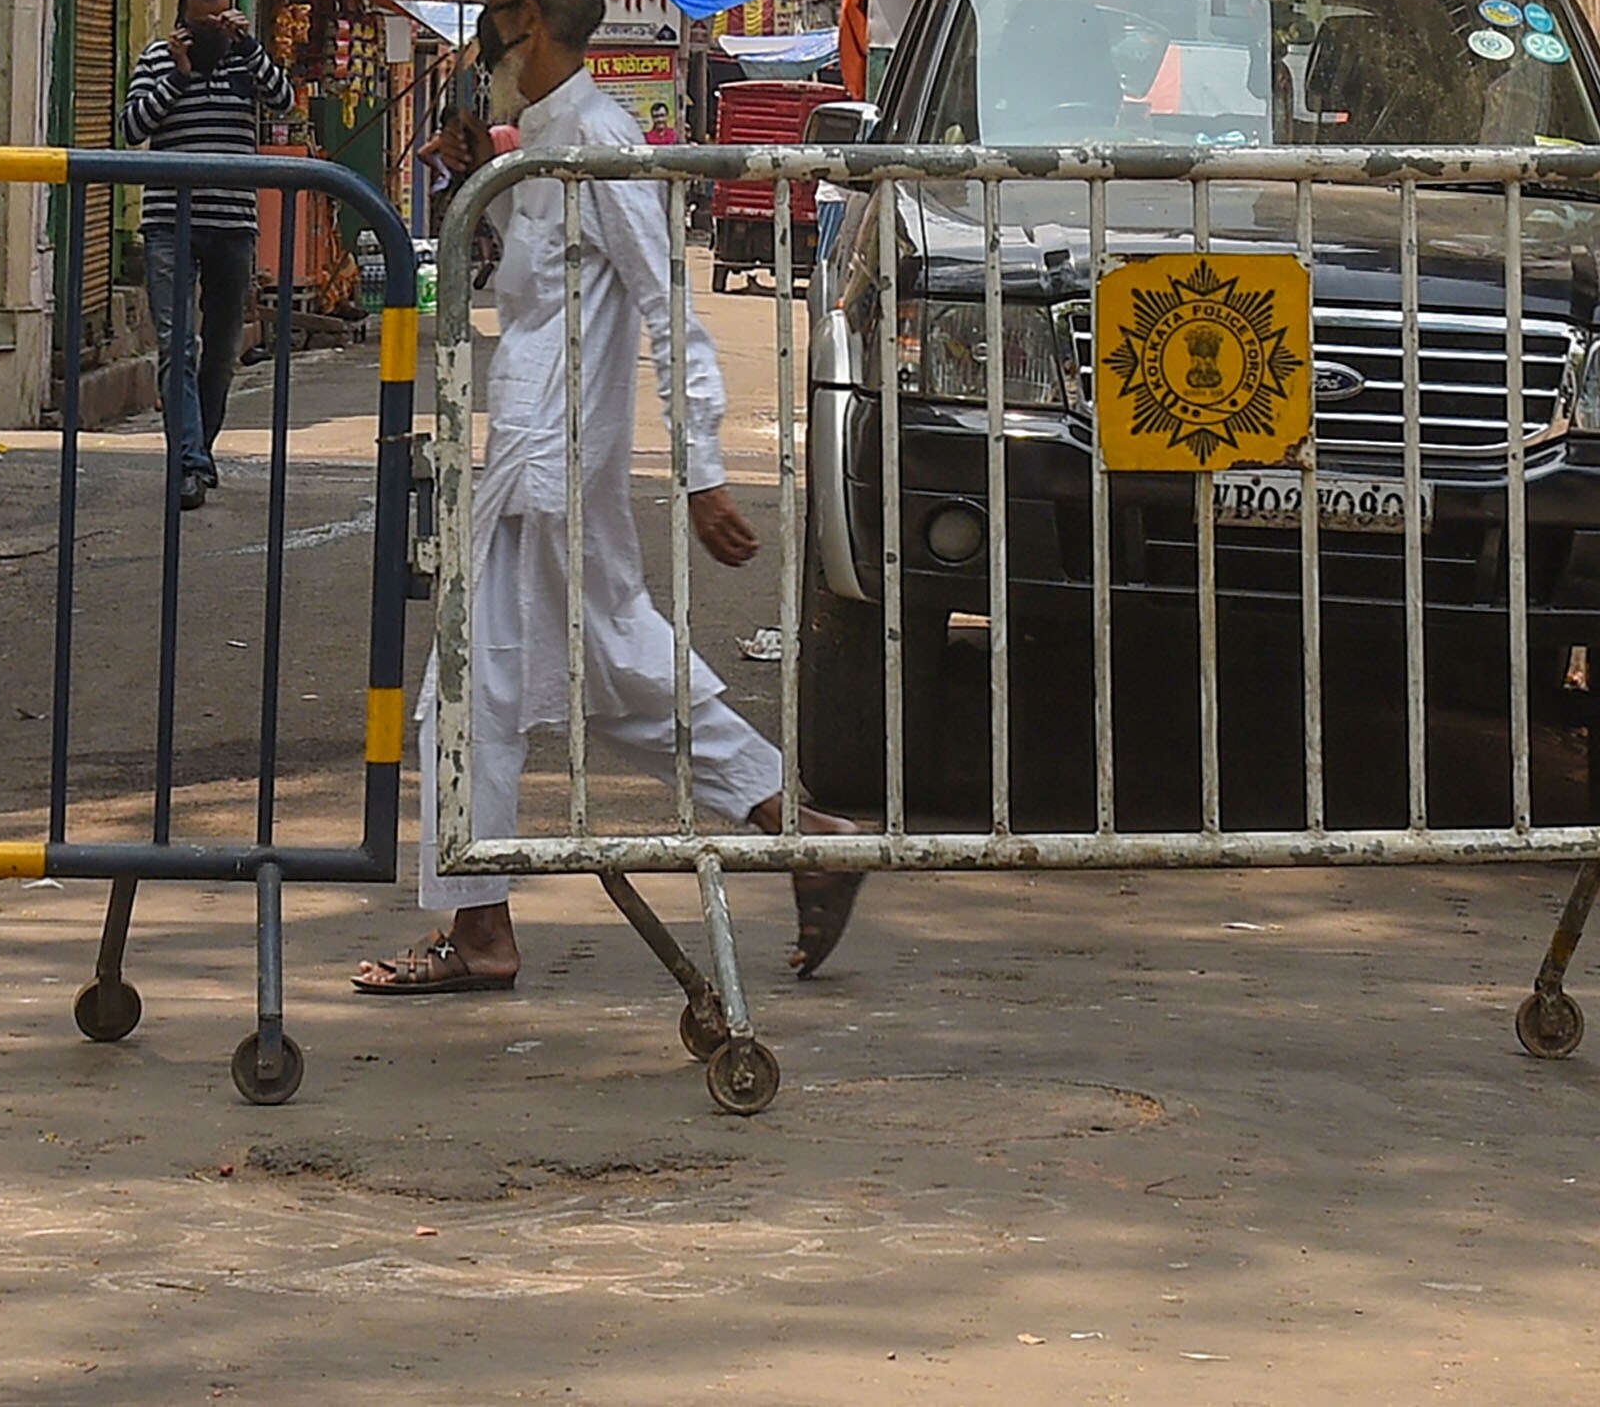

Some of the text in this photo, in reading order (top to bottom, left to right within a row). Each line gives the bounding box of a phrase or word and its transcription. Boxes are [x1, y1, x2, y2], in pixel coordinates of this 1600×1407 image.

[1145, 304, 1263, 393] KOLKATA POLICE FORCE
